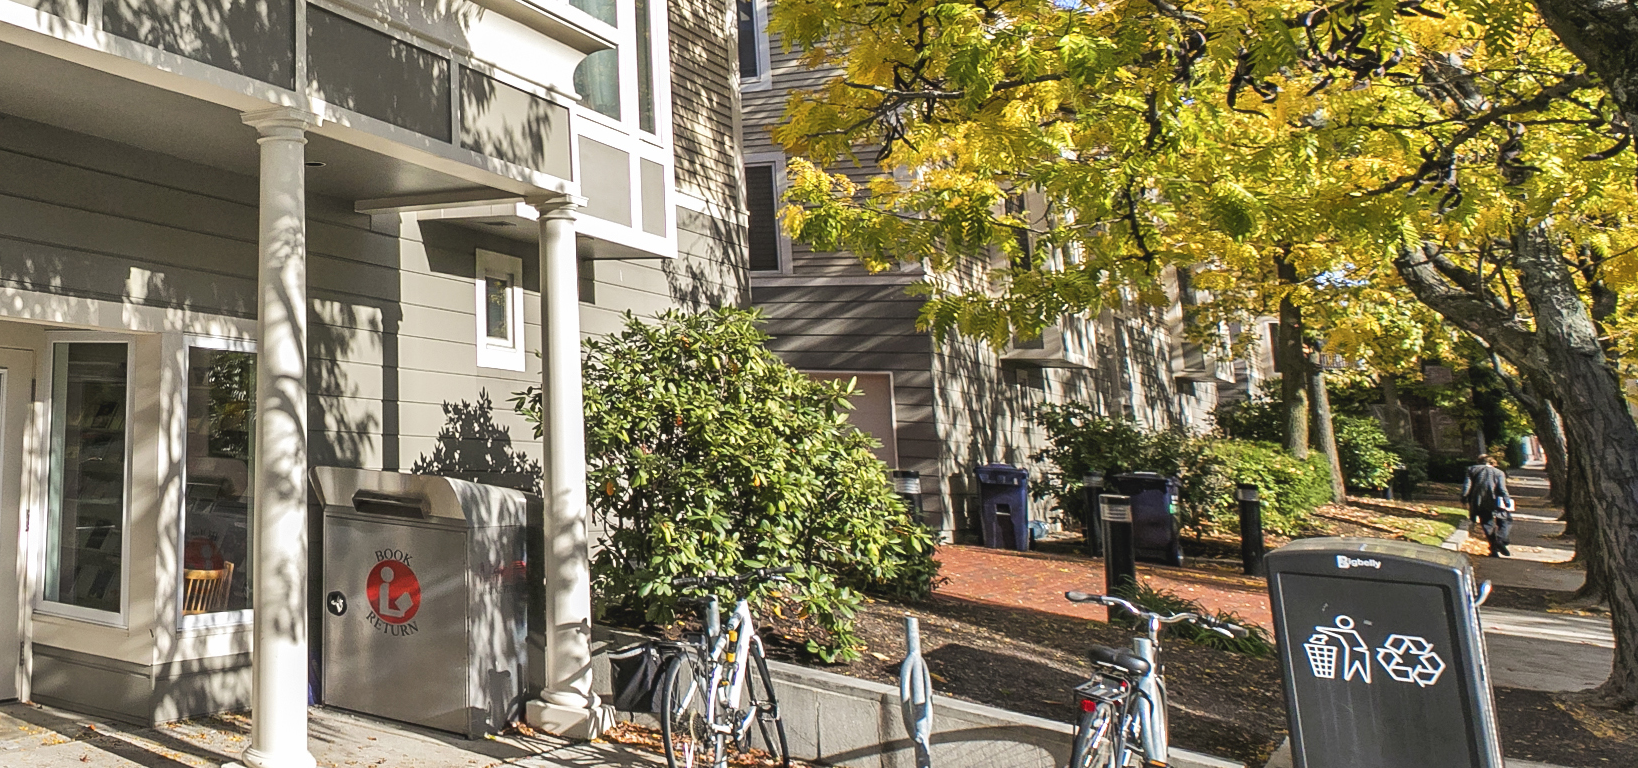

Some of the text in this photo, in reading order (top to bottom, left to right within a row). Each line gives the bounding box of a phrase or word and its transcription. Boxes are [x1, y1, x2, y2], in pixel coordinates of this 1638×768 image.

[375, 548, 413, 567] BOOK
[1336, 555, 1382, 569] Bigbelly
[365, 611, 419, 637] RETURN
